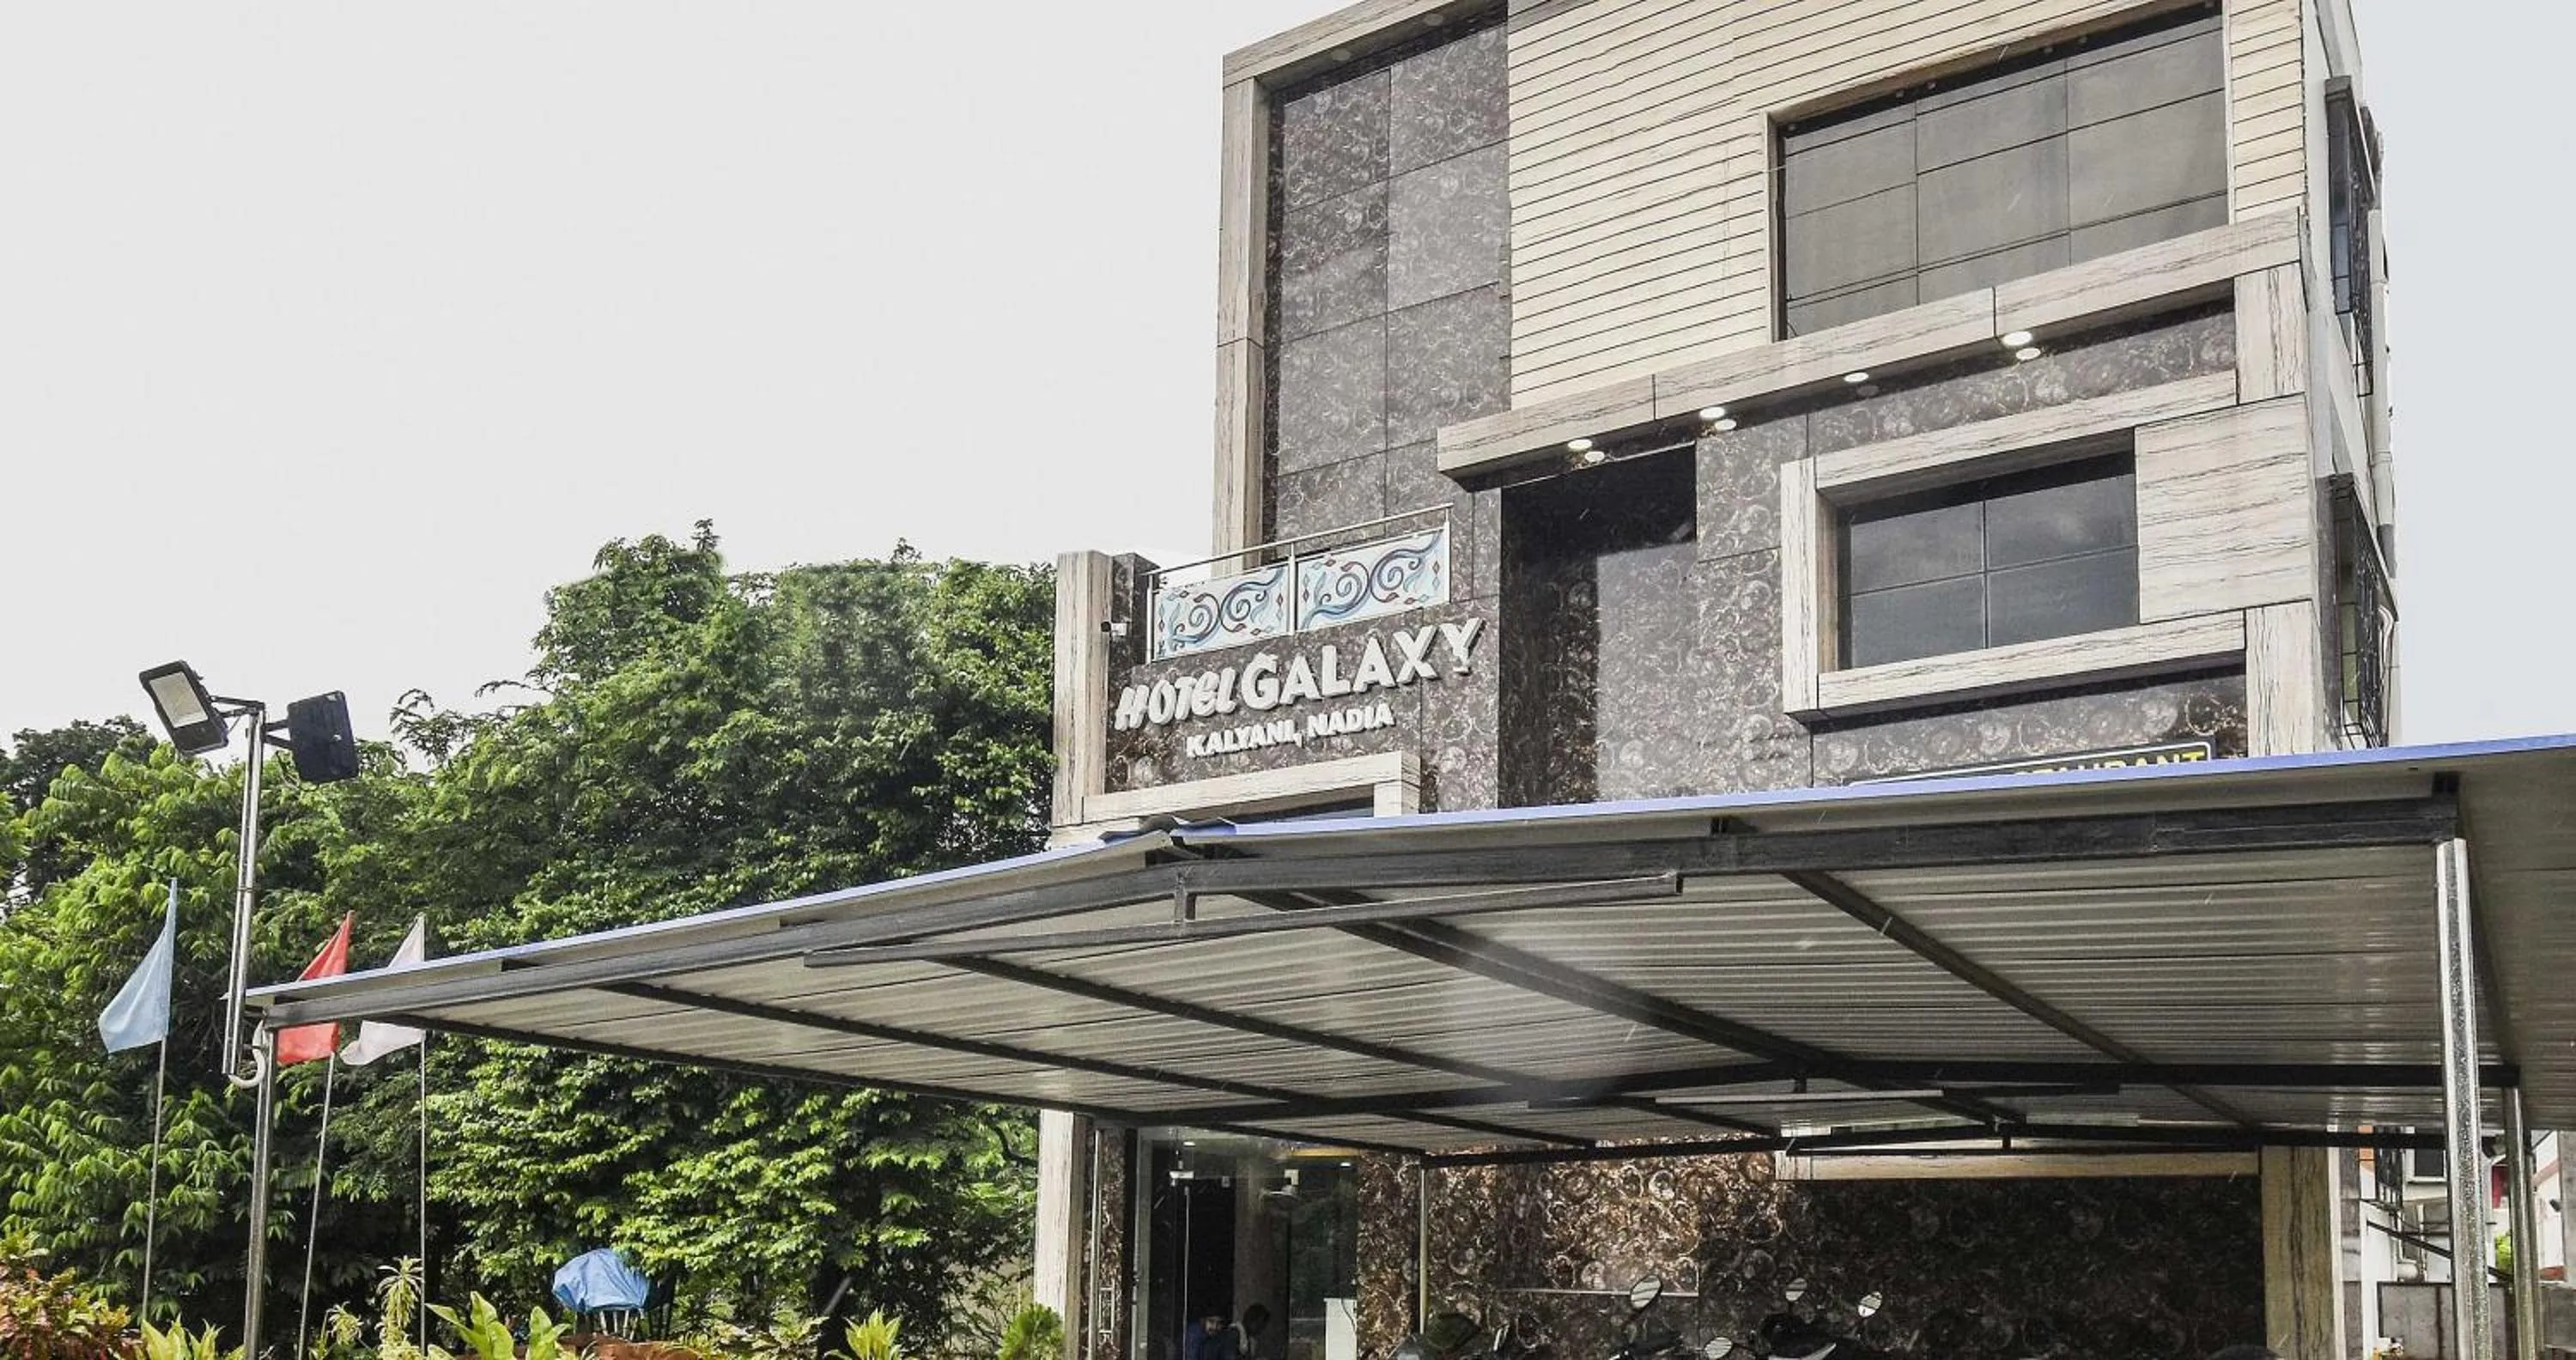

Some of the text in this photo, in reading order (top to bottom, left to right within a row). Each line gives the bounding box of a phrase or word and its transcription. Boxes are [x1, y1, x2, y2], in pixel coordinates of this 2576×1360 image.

[1242, 618, 1485, 711] GALAXY
[1186, 702, 1395, 758] KALYANI, NADIA
